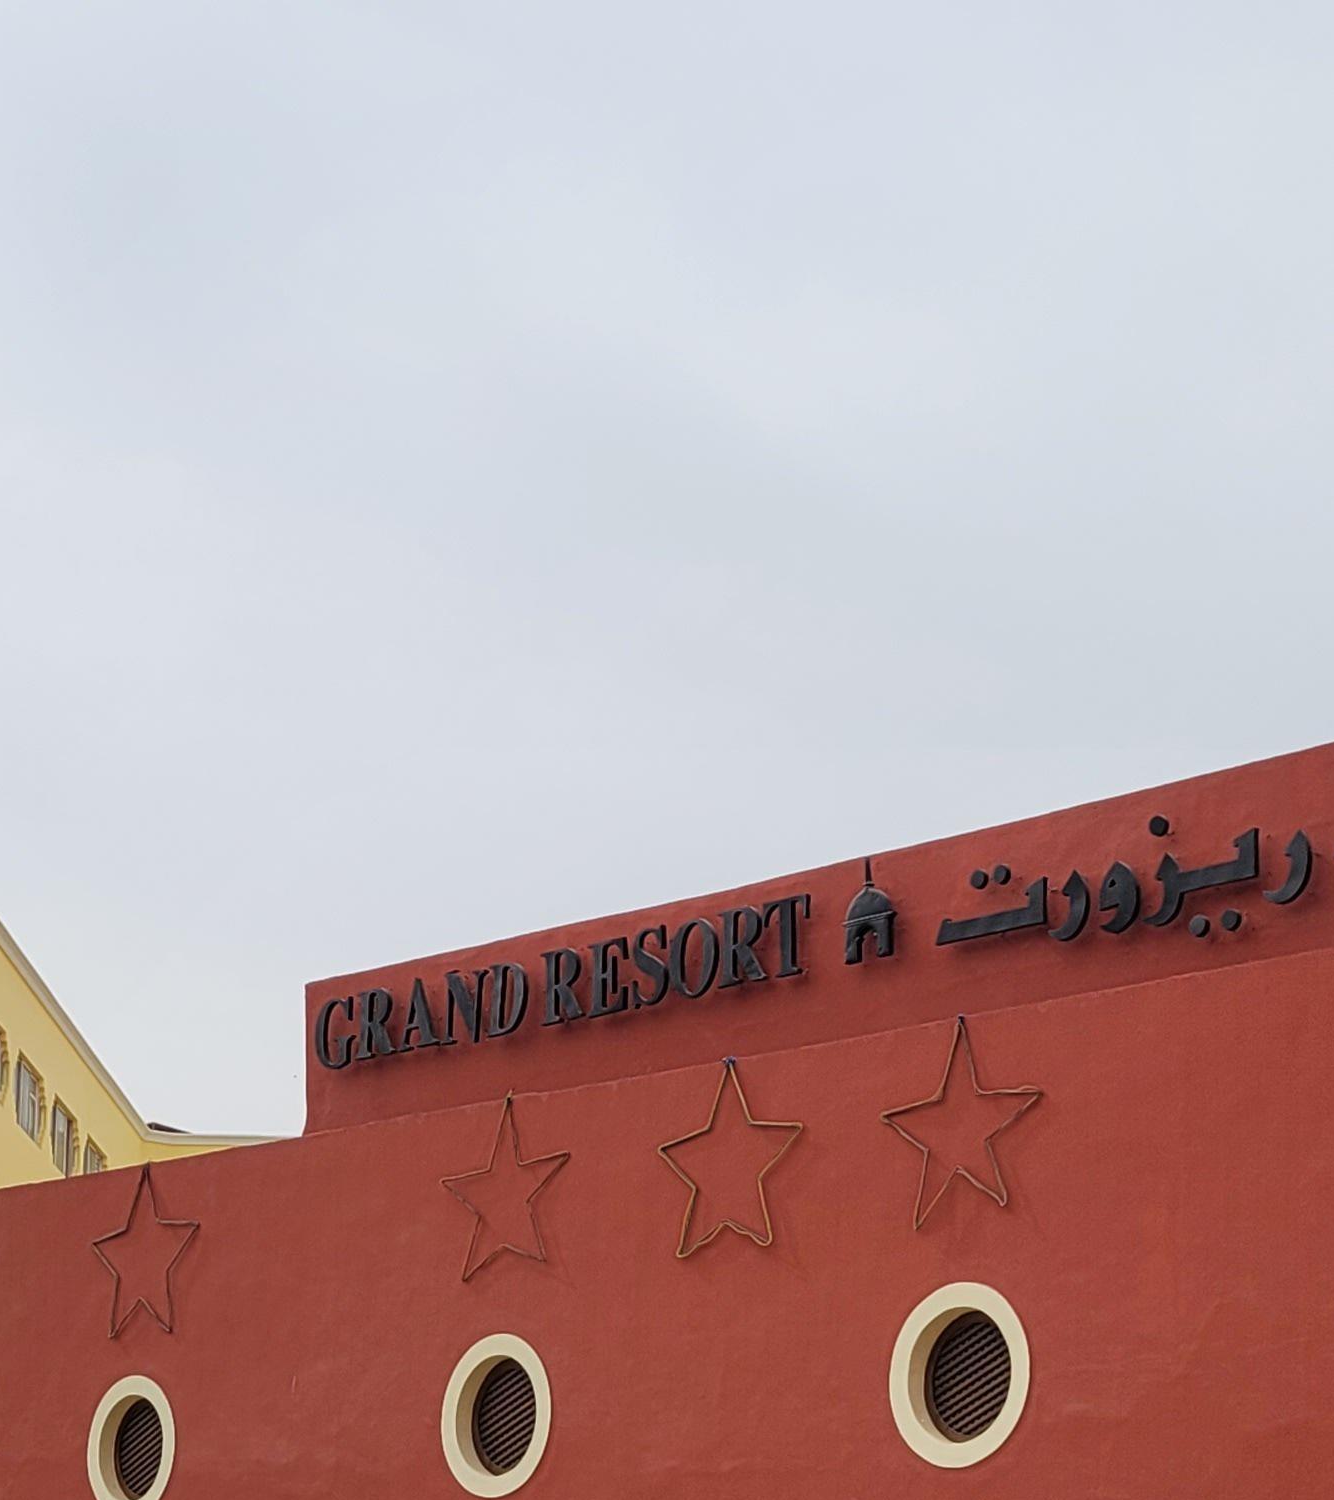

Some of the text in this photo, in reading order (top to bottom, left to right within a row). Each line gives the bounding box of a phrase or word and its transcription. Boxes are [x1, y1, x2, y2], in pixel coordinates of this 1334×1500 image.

[935, 815, 1314, 946] ريزورت
[315, 894, 811, 1070] GRAND RESORT
